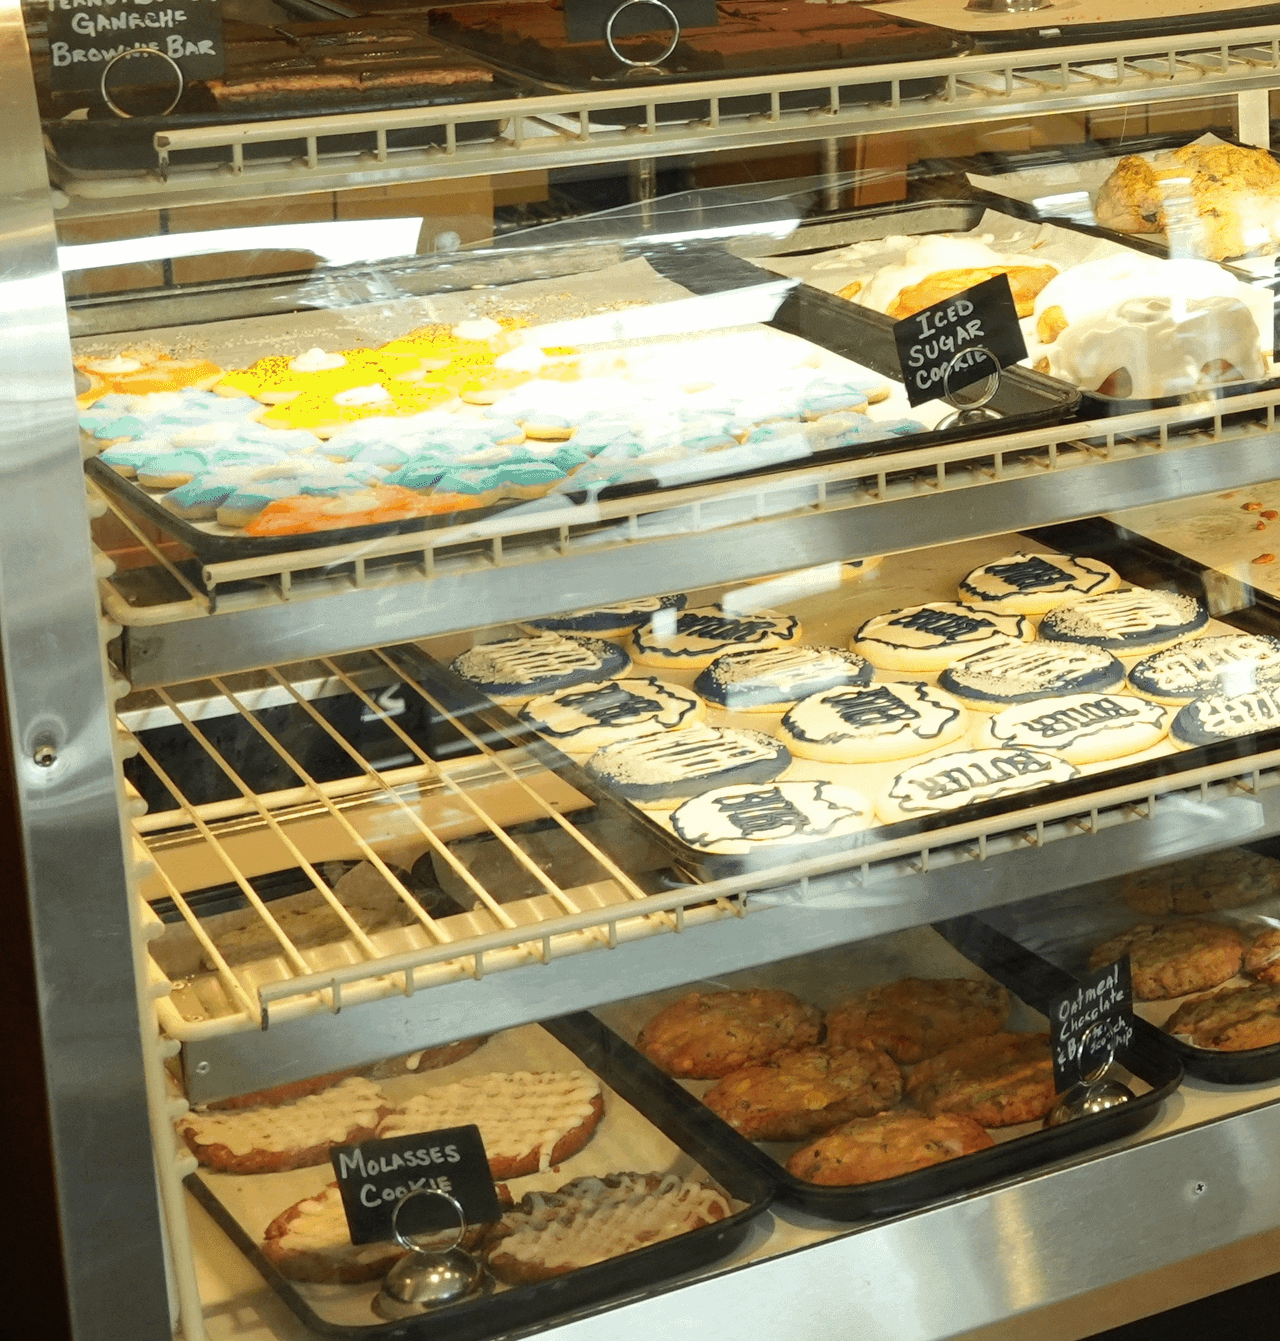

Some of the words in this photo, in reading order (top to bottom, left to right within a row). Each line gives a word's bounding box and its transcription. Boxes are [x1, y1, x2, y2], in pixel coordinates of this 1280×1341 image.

[165, 34, 216, 59] BAR
[916, 299, 975, 339] ICED
[908, 319, 985, 367] SUGAR
[1015, 697, 1139, 739] BUTLER
[909, 750, 1051, 801] BUTLER
[1058, 963, 1119, 1022] Oatmeal
[1060, 990, 1124, 1042] Chocolate
[339, 1144, 461, 1179] MOLASSES
[359, 1175, 452, 1208] COOKIE
